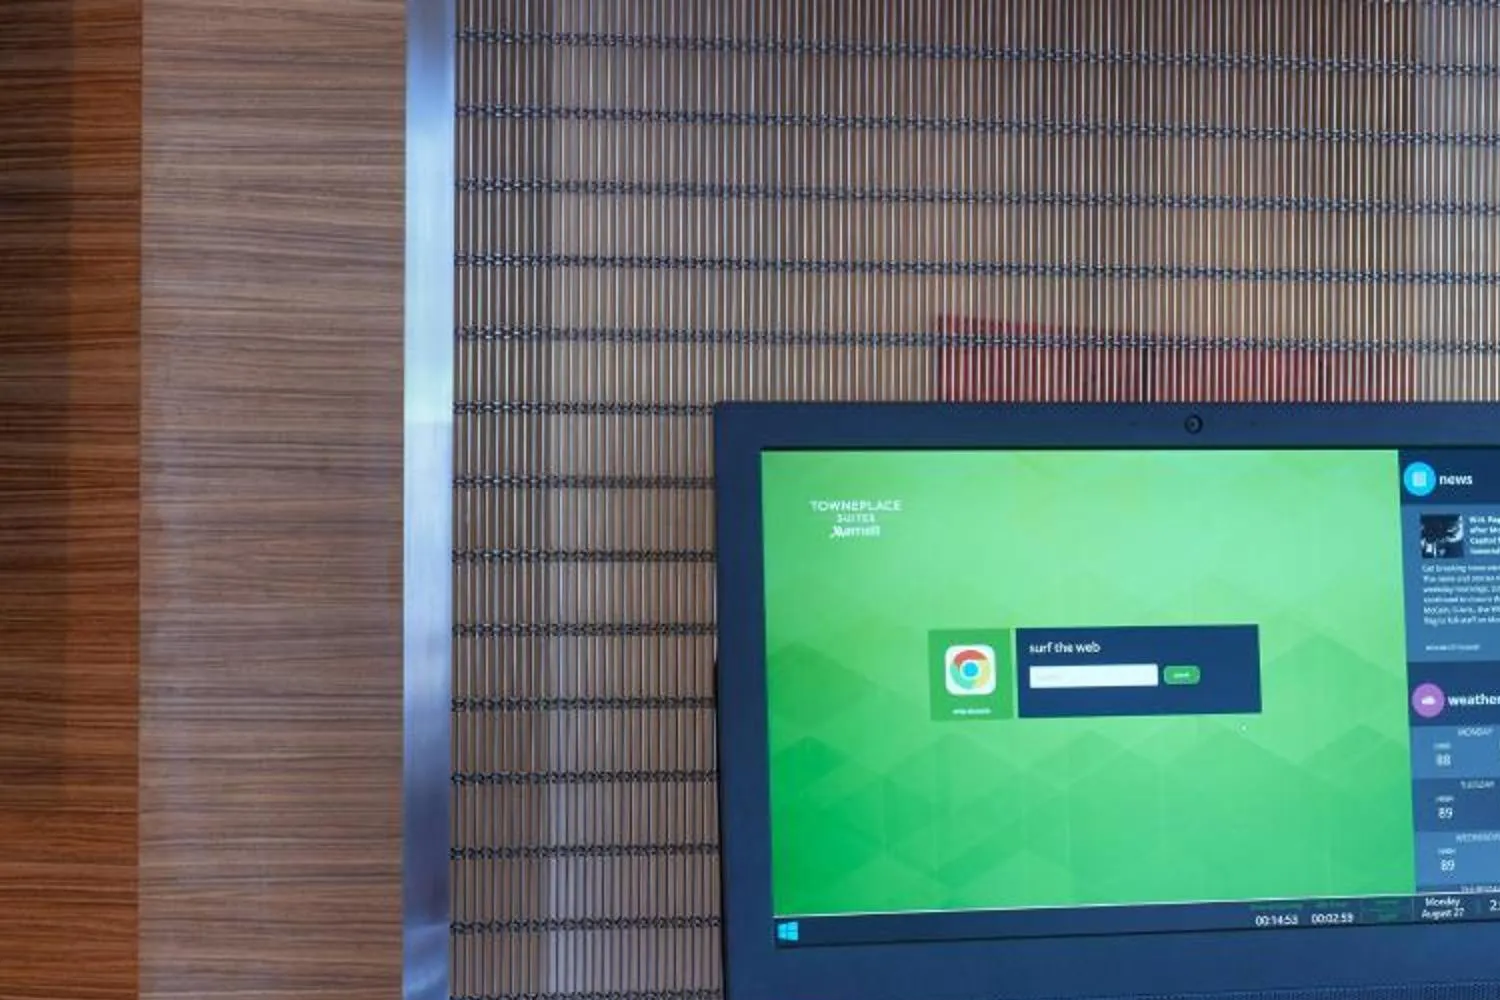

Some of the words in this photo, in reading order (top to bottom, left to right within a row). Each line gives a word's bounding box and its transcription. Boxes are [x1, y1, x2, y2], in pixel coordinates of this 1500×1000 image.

[1439, 473, 1474, 486] news
[809, 499, 903, 511] TOWNEPLACE
[1029, 640, 1052, 654] surf
[1054, 641, 1073, 654] the
[1075, 640, 1101, 654] web
